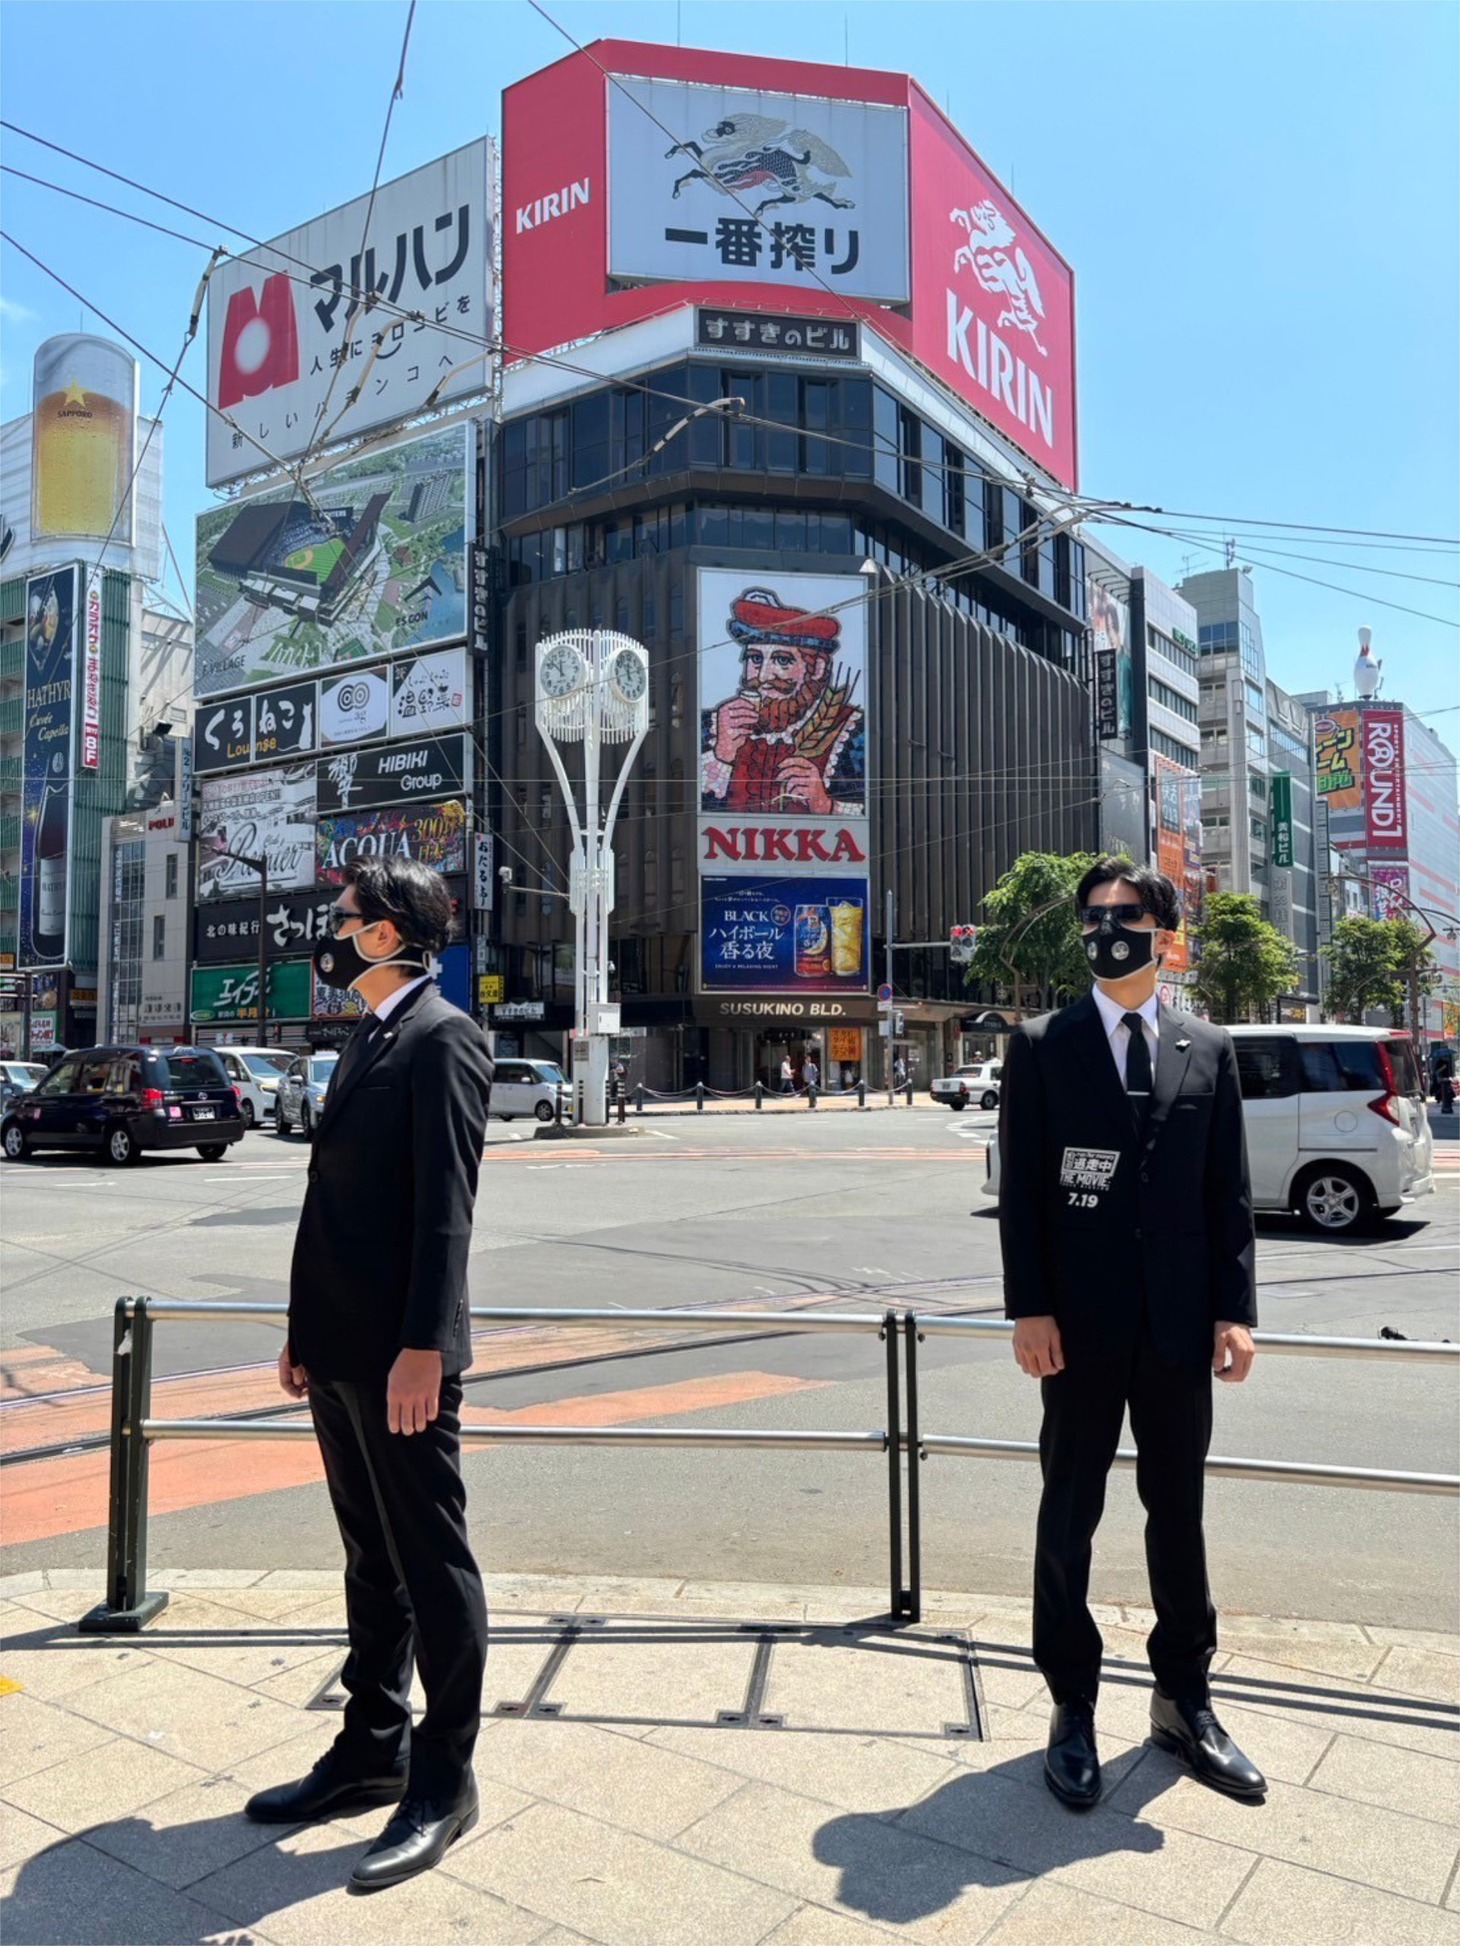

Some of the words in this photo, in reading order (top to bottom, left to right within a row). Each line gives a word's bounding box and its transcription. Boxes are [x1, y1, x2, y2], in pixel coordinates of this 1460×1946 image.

[515, 177, 590, 235] KIRIN
[664, 216, 860, 276] 一番搾り
[309, 203, 470, 334] マルハン
[705, 317, 849, 350] すすきのビル
[945, 286, 1054, 449] KIRIN
[57, 410, 93, 418] SAPPORO
[27, 680, 72, 708] HATHYR
[1100, 653, 1115, 734] すすきのビル
[29, 711, 54, 728] Cuvée
[204, 698, 295, 751] くろねこ
[38, 724, 70, 742] Capella
[86, 736, 97, 763] 8F
[226, 737, 277, 759] Lounge
[377, 750, 428, 774] HIBIKI
[401, 774, 443, 791] Group
[1367, 722, 1403, 837] ROUND1
[702, 826, 867, 862] NIKKA
[724, 910, 769, 922] BLACK
[206, 921, 261, 939] 北の味紀行
[709, 925, 784, 941] ハイボール
[720, 941, 775, 960] 香る夜
[719, 1002, 804, 1016] SUSUKINO
[809, 1002, 847, 1016] BLD.
[1073, 1157, 1112, 1172] 逃走中
[1068, 1192, 1099, 1207] 7.19
